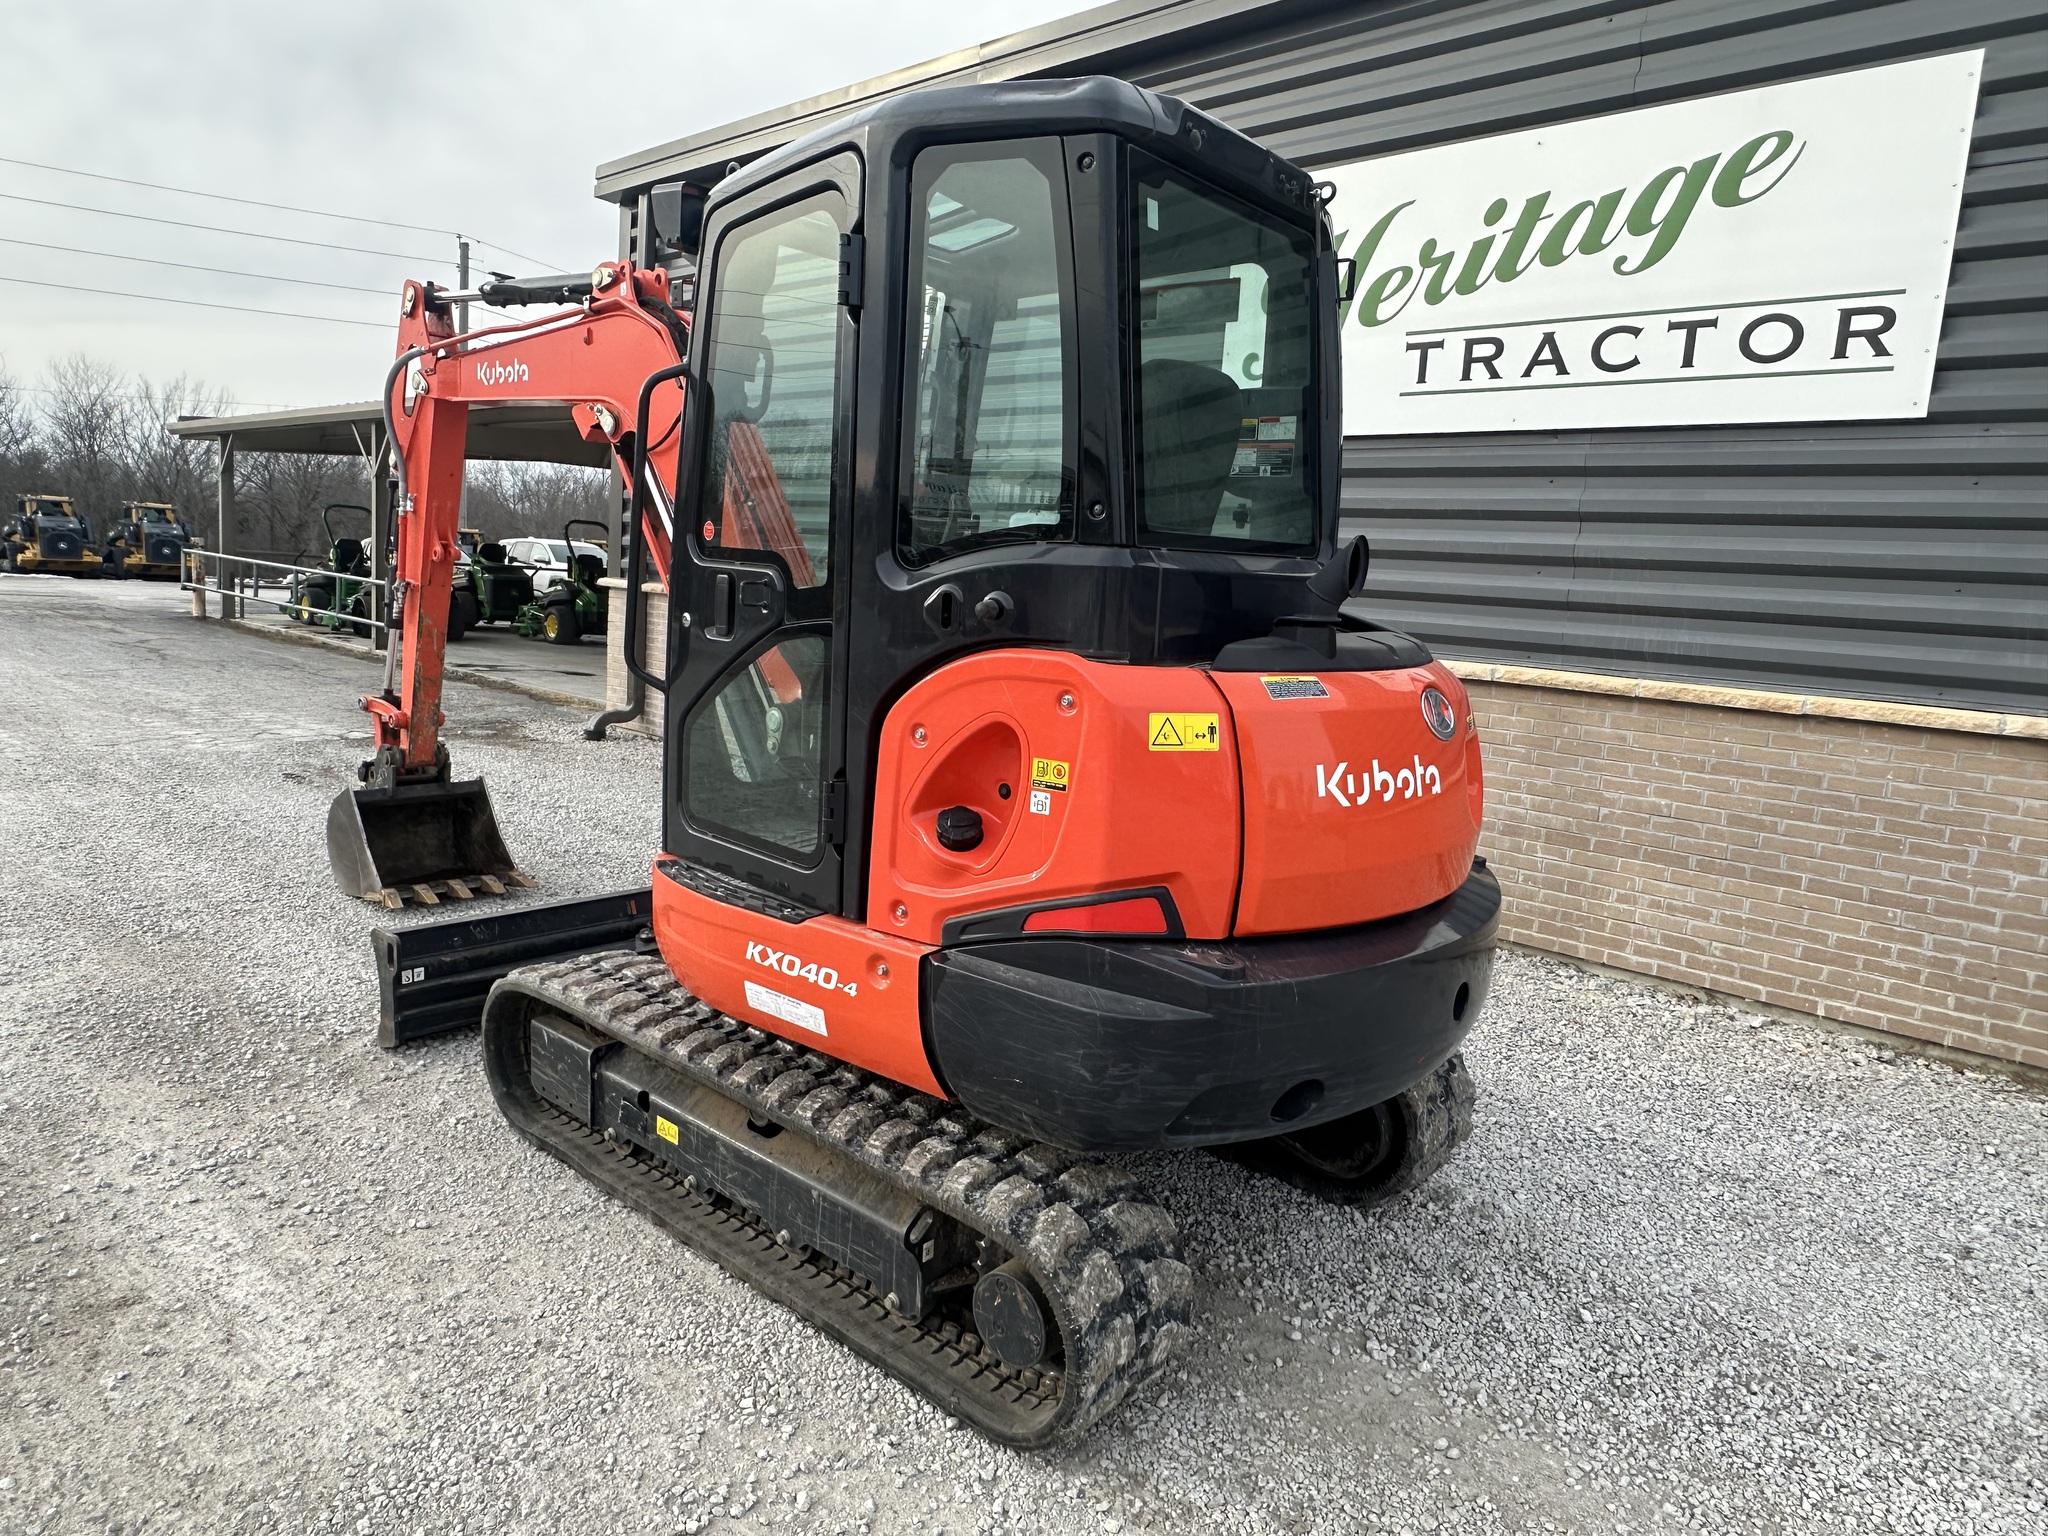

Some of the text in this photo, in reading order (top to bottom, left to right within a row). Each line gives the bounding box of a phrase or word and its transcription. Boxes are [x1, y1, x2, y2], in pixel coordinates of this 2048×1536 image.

[477, 357, 529, 386] Kubota
[1405, 305, 1897, 385] TRACTOR
[1316, 754, 1442, 807] Kubota
[745, 941, 858, 998] KX040-4
